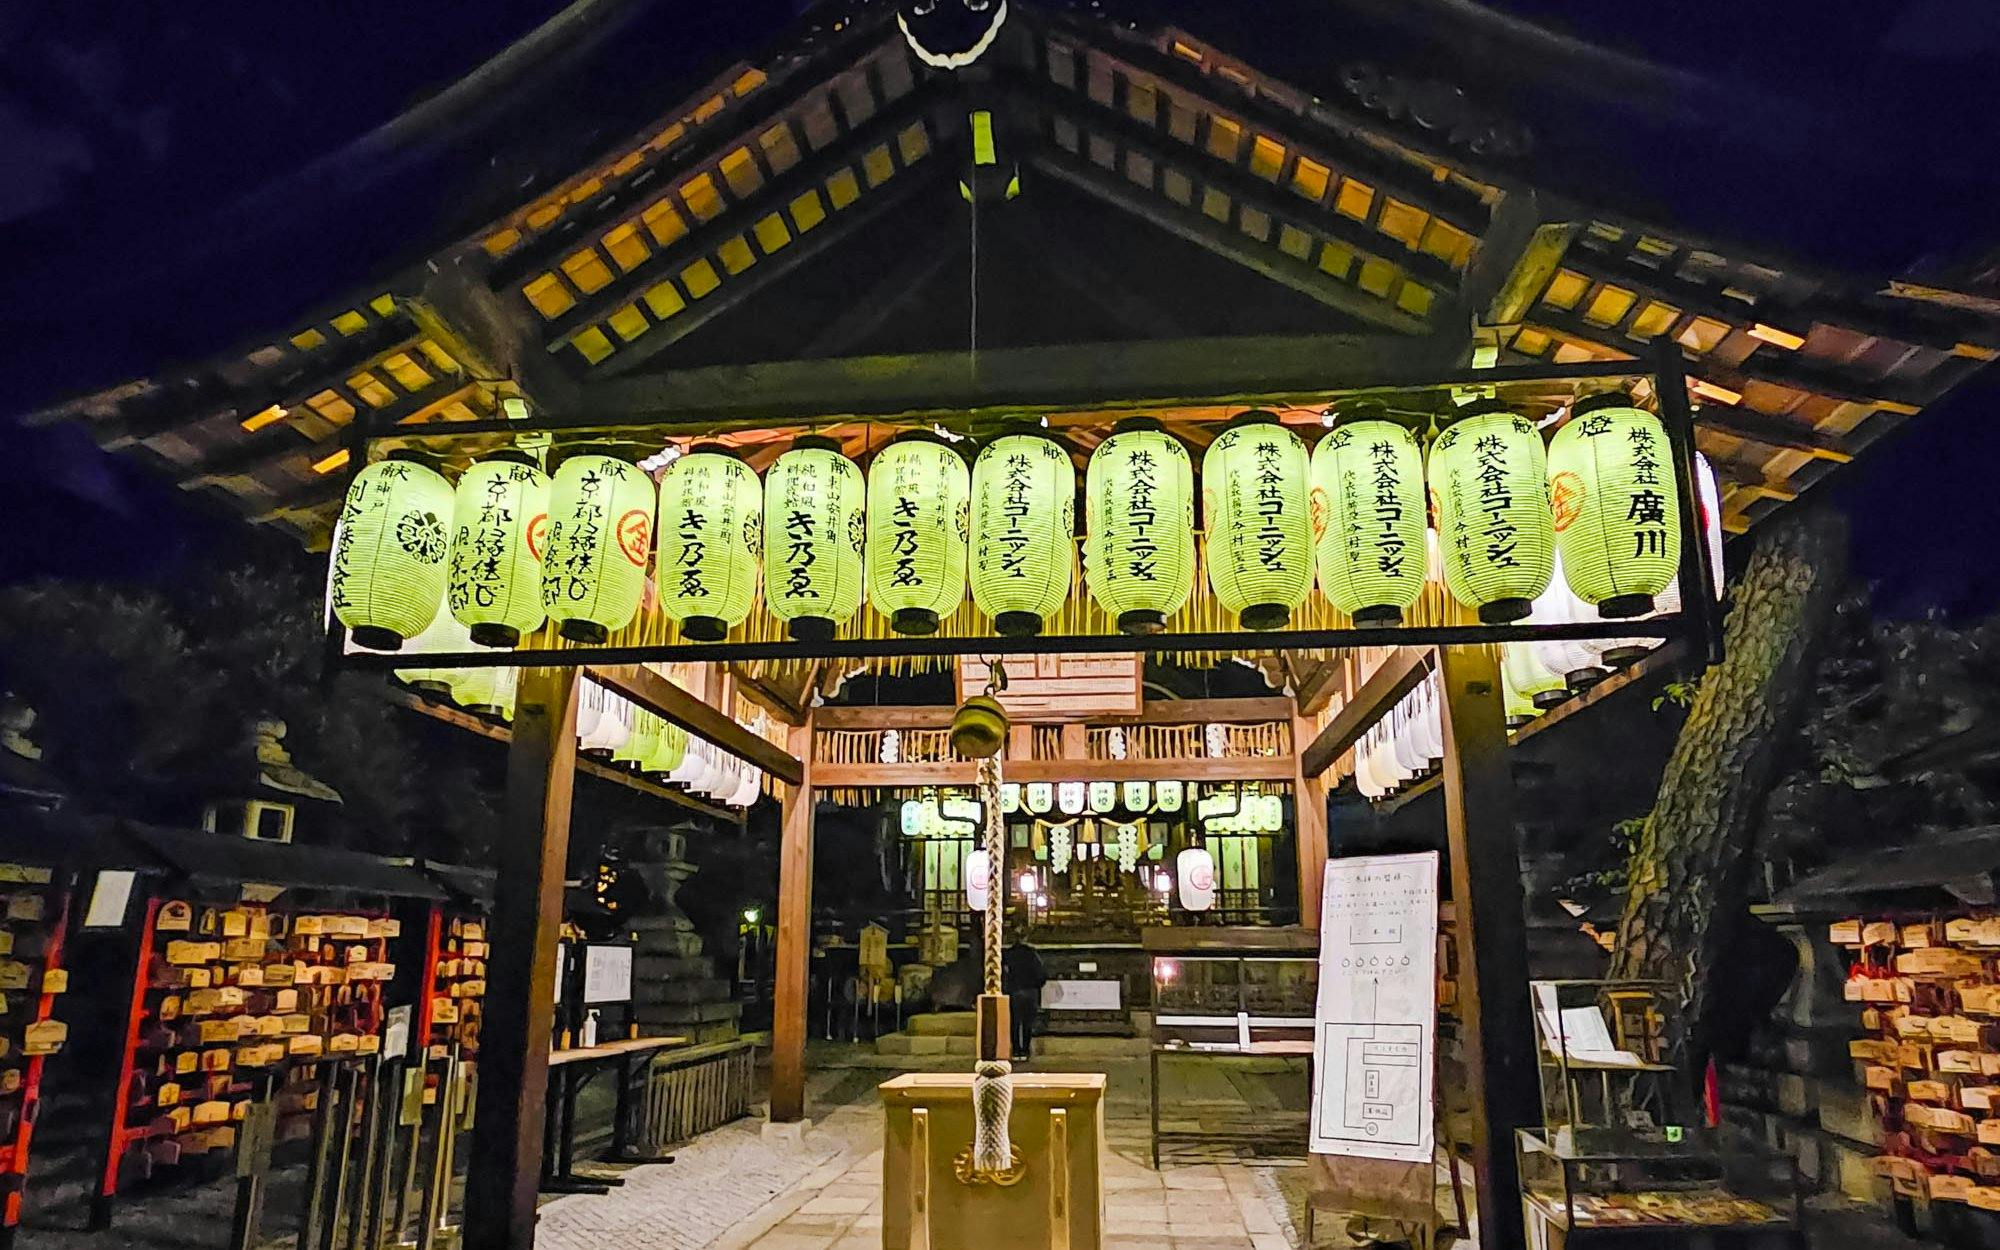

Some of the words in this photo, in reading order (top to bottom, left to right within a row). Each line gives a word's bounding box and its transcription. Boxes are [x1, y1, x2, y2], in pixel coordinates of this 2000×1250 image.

[470, 473, 513, 607] 京都縁結び
[564, 470, 603, 601] 京都縁結び
[999, 453, 1033, 577] 株式会社コーニッシュ
[1125, 450, 1158, 581] 株式会社コーニッシュ
[1254, 442, 1287, 572] 株式会社コーニッシュ
[1369, 440, 1406, 577] 株式会社コーニッシュ
[1472, 434, 1520, 570] 株式会社コーニッシュ
